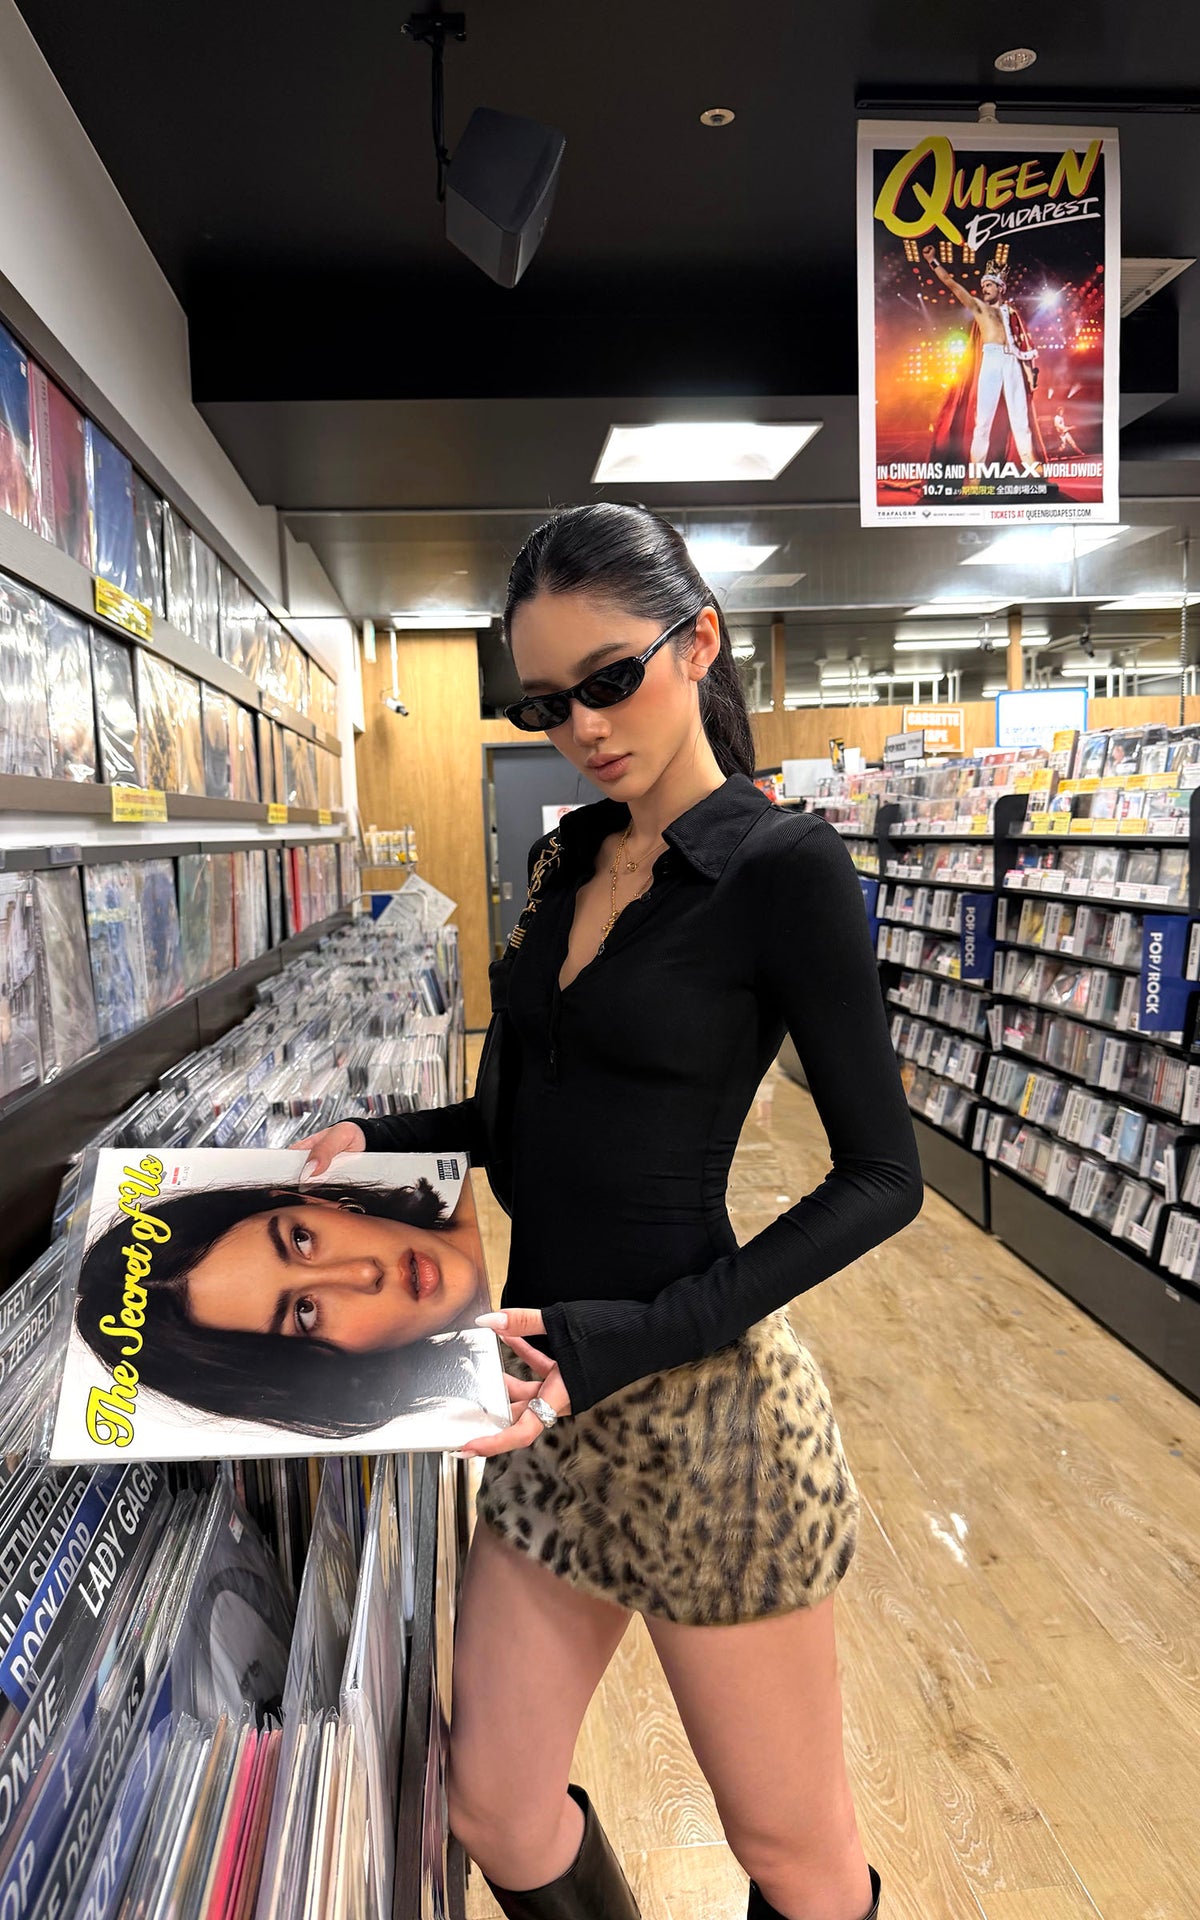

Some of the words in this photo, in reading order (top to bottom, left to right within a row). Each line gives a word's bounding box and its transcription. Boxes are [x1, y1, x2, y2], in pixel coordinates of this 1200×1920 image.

[874, 136, 1103, 246] QUEEN
[965, 197, 1100, 251] BUDAPEST
[877, 466, 888, 479] IN
[889, 463, 943, 479] CINEMAS
[944, 465, 965, 479] AND
[968, 461, 1042, 478] IMAX
[1043, 462, 1103, 477] WORLDWIDE
[922, 485, 943, 495] 10.7
[990, 510, 1016, 520] TICKETS
[1017, 510, 1025, 518] AT
[1025, 509, 1092, 520] QUEENBUDAPEST.COM
[963, 906, 976, 967] POP/ROCK
[1145, 932, 1163, 1015] POP/ROCK
[118, 1199, 172, 1244] of
[98, 1242, 153, 1357] Secret
[85, 1360, 140, 1448] The
[78, 1520, 125, 1619] LADY
[116, 1461, 158, 1536] GAGA
